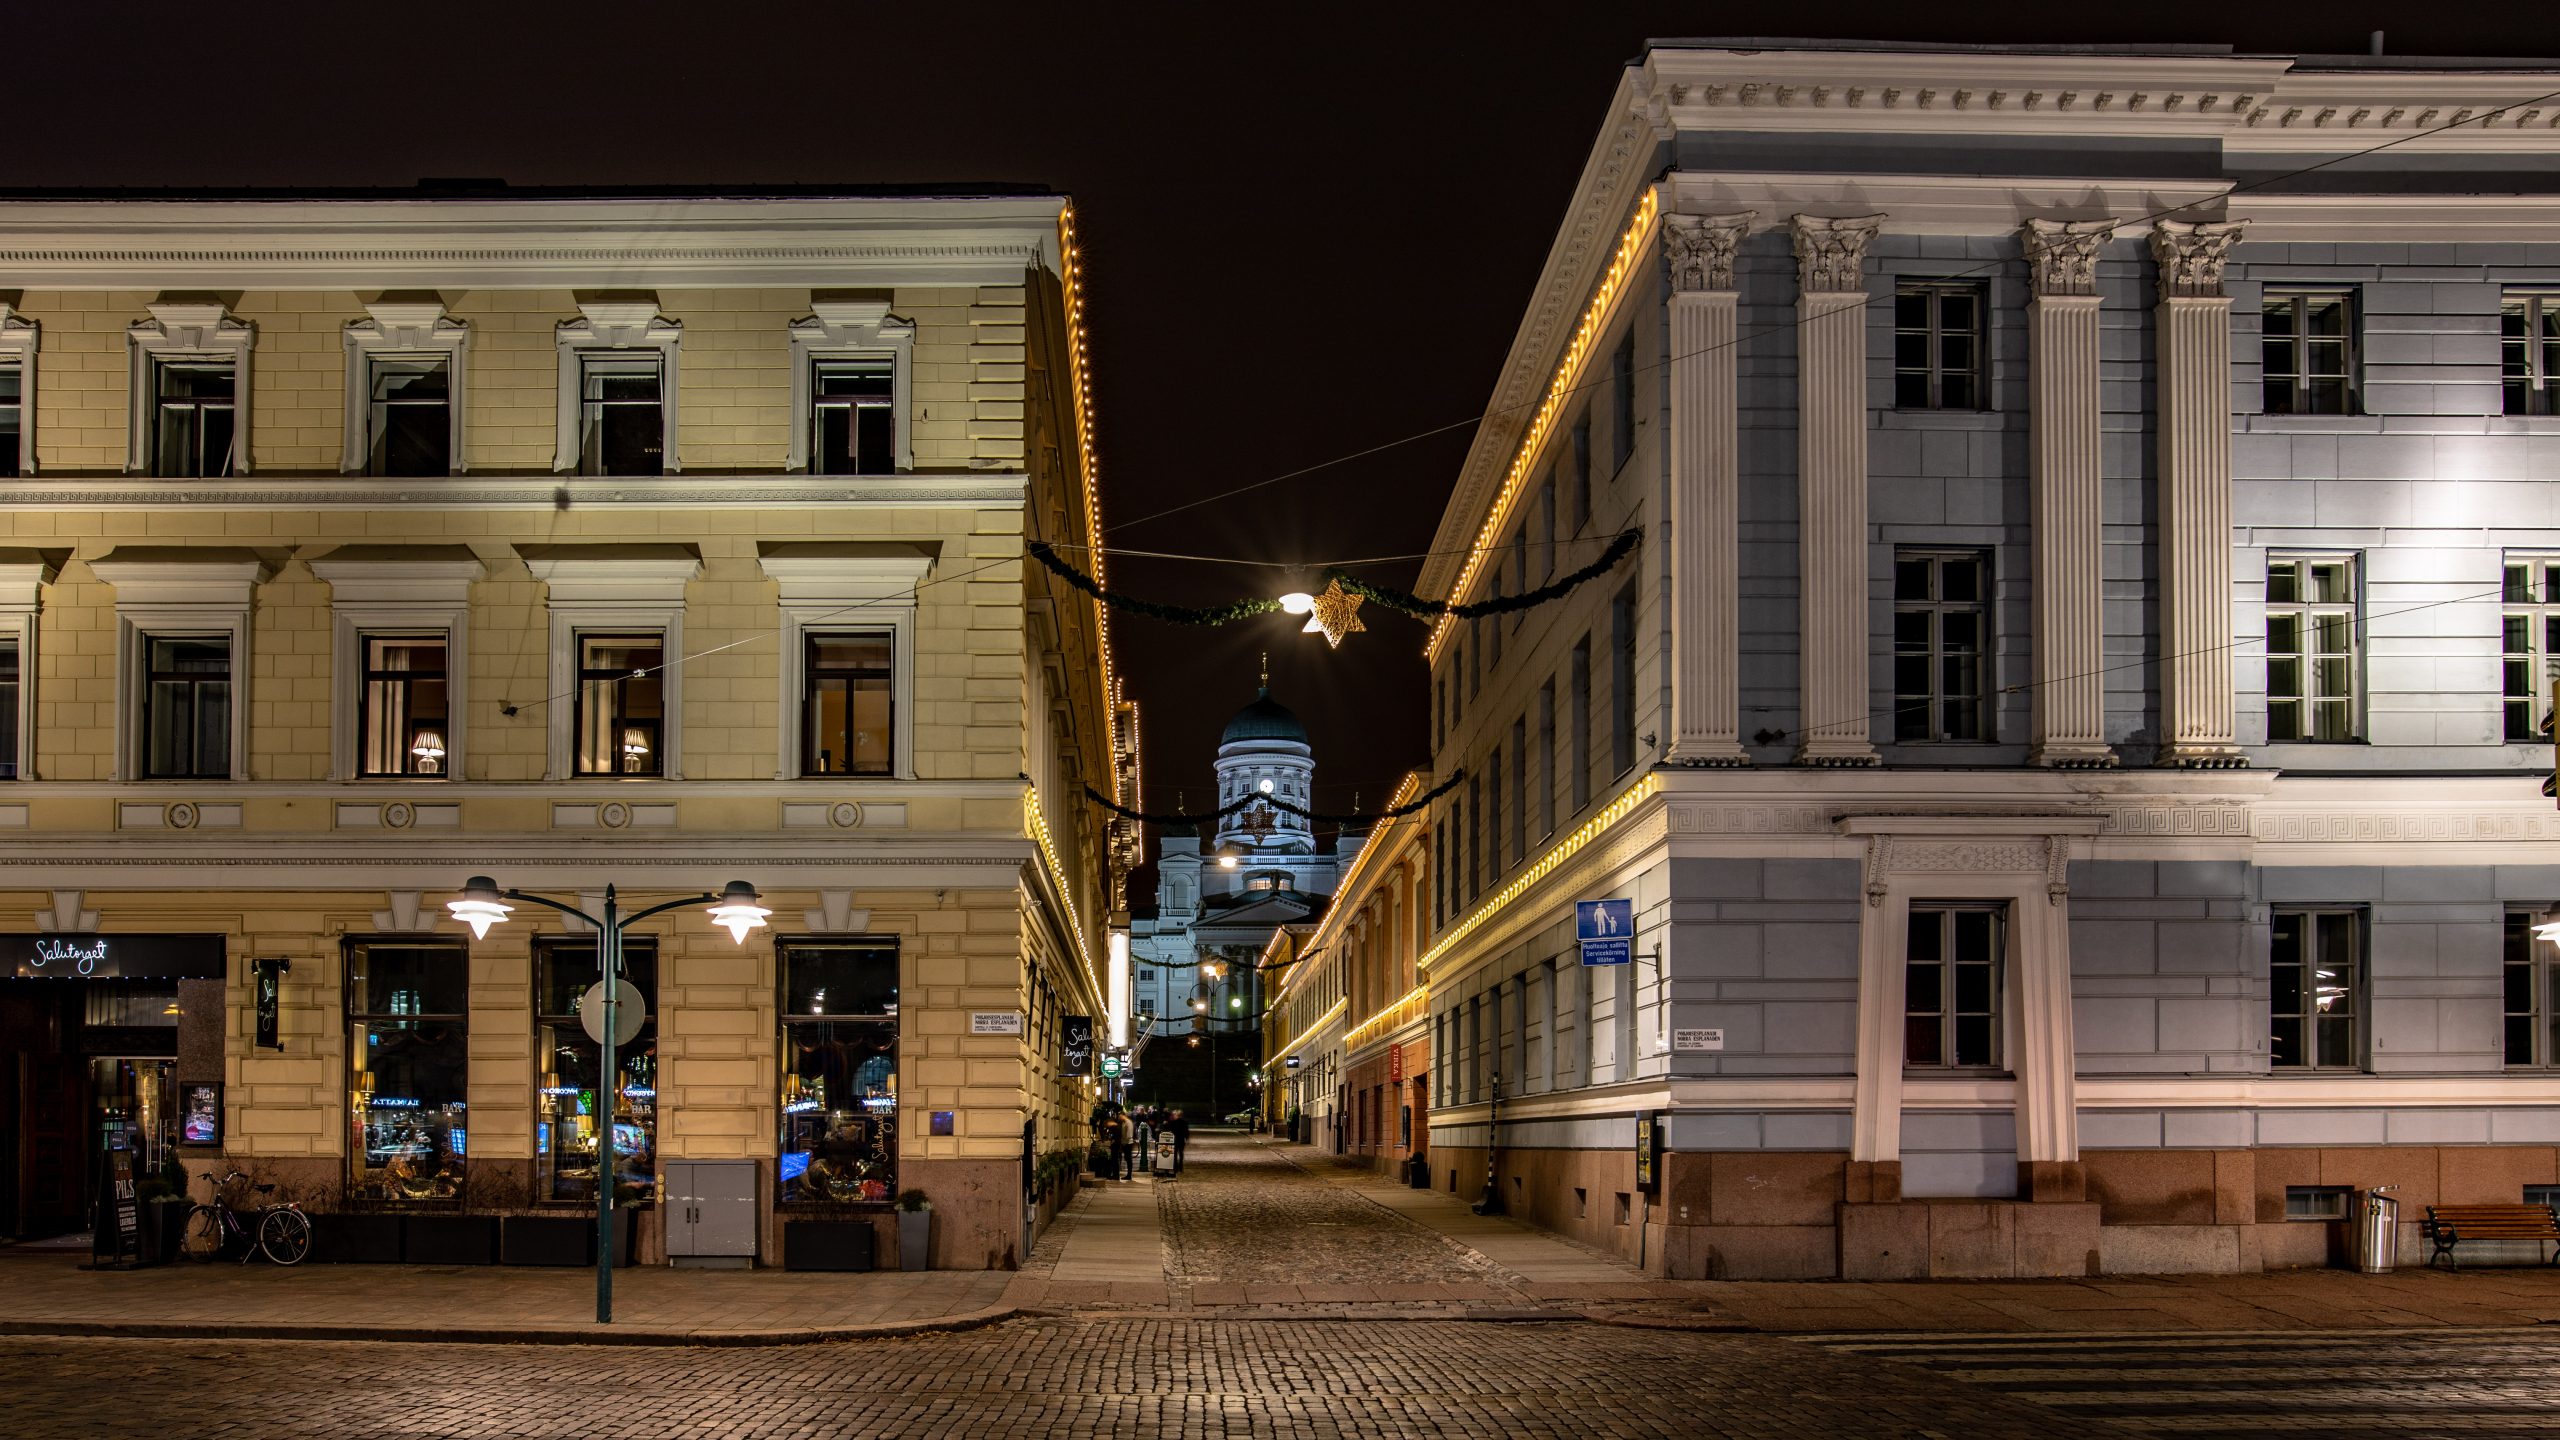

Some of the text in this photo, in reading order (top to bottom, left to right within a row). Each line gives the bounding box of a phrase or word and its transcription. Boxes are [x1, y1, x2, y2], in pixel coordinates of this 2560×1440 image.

[31, 939, 107, 975] Salutorget
[1068, 1028, 1092, 1046] Salu
[1064, 1045, 1092, 1067] torget
[442, 1104, 462, 1113] BAR
[632, 1104, 652, 1113] BAR
[872, 1106, 892, 1114] BAR
[116, 1179, 135, 1200] PILS
